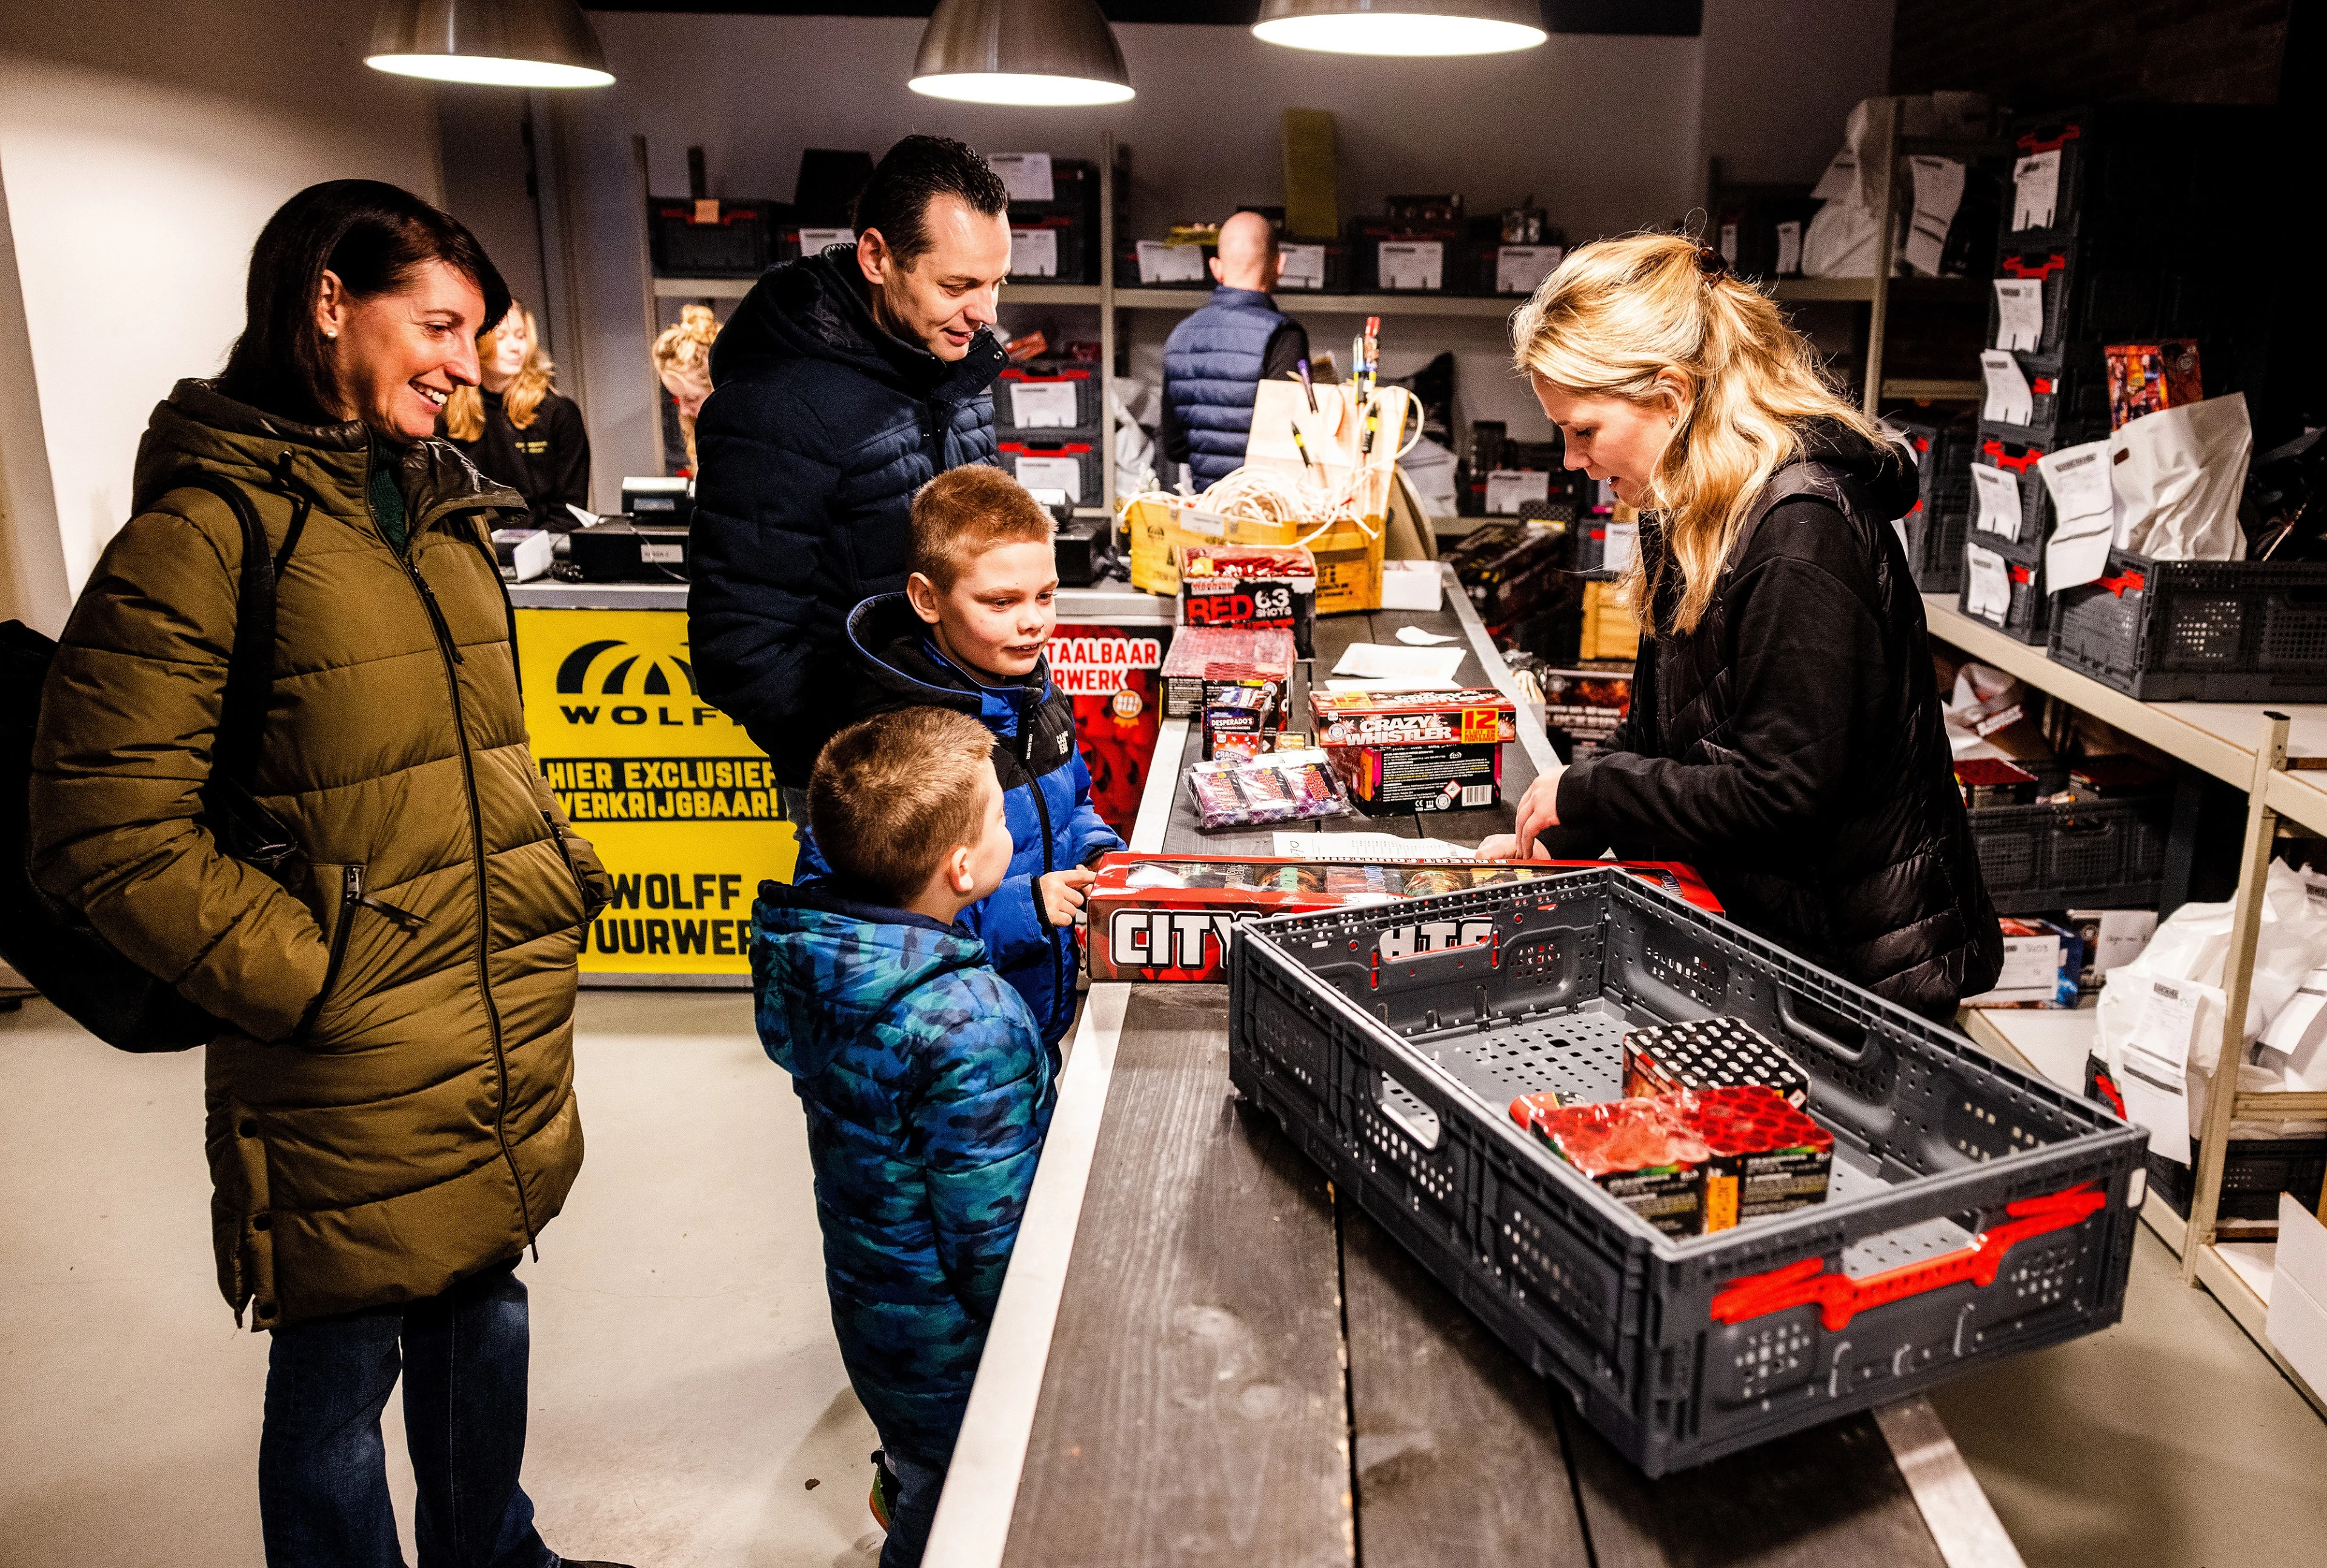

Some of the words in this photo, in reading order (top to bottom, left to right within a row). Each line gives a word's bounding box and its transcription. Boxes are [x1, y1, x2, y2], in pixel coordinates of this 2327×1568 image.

[1255, 588, 1290, 608] 63
[1187, 594, 1254, 626] RED
[1255, 606, 1293, 618] SHOTS
[1049, 669, 1123, 689] RWERK
[559, 706, 742, 726] WOLF
[1211, 718, 1254, 726] DESPERADO'S
[1359, 714, 1433, 733] CRAZY
[1465, 710, 1496, 729] 12
[1346, 726, 1453, 746] WHISTLER
[547, 762, 613, 789] HIER
[624, 762, 776, 788] EXCLUSIEF
[1311, 771, 1331, 799] DISCO
[554, 788, 779, 818] VERKRIJGBAAR!
[608, 874, 742, 909] WOLFF
[578, 919, 751, 955] UURWER
[1113, 911, 1259, 968] CITY
